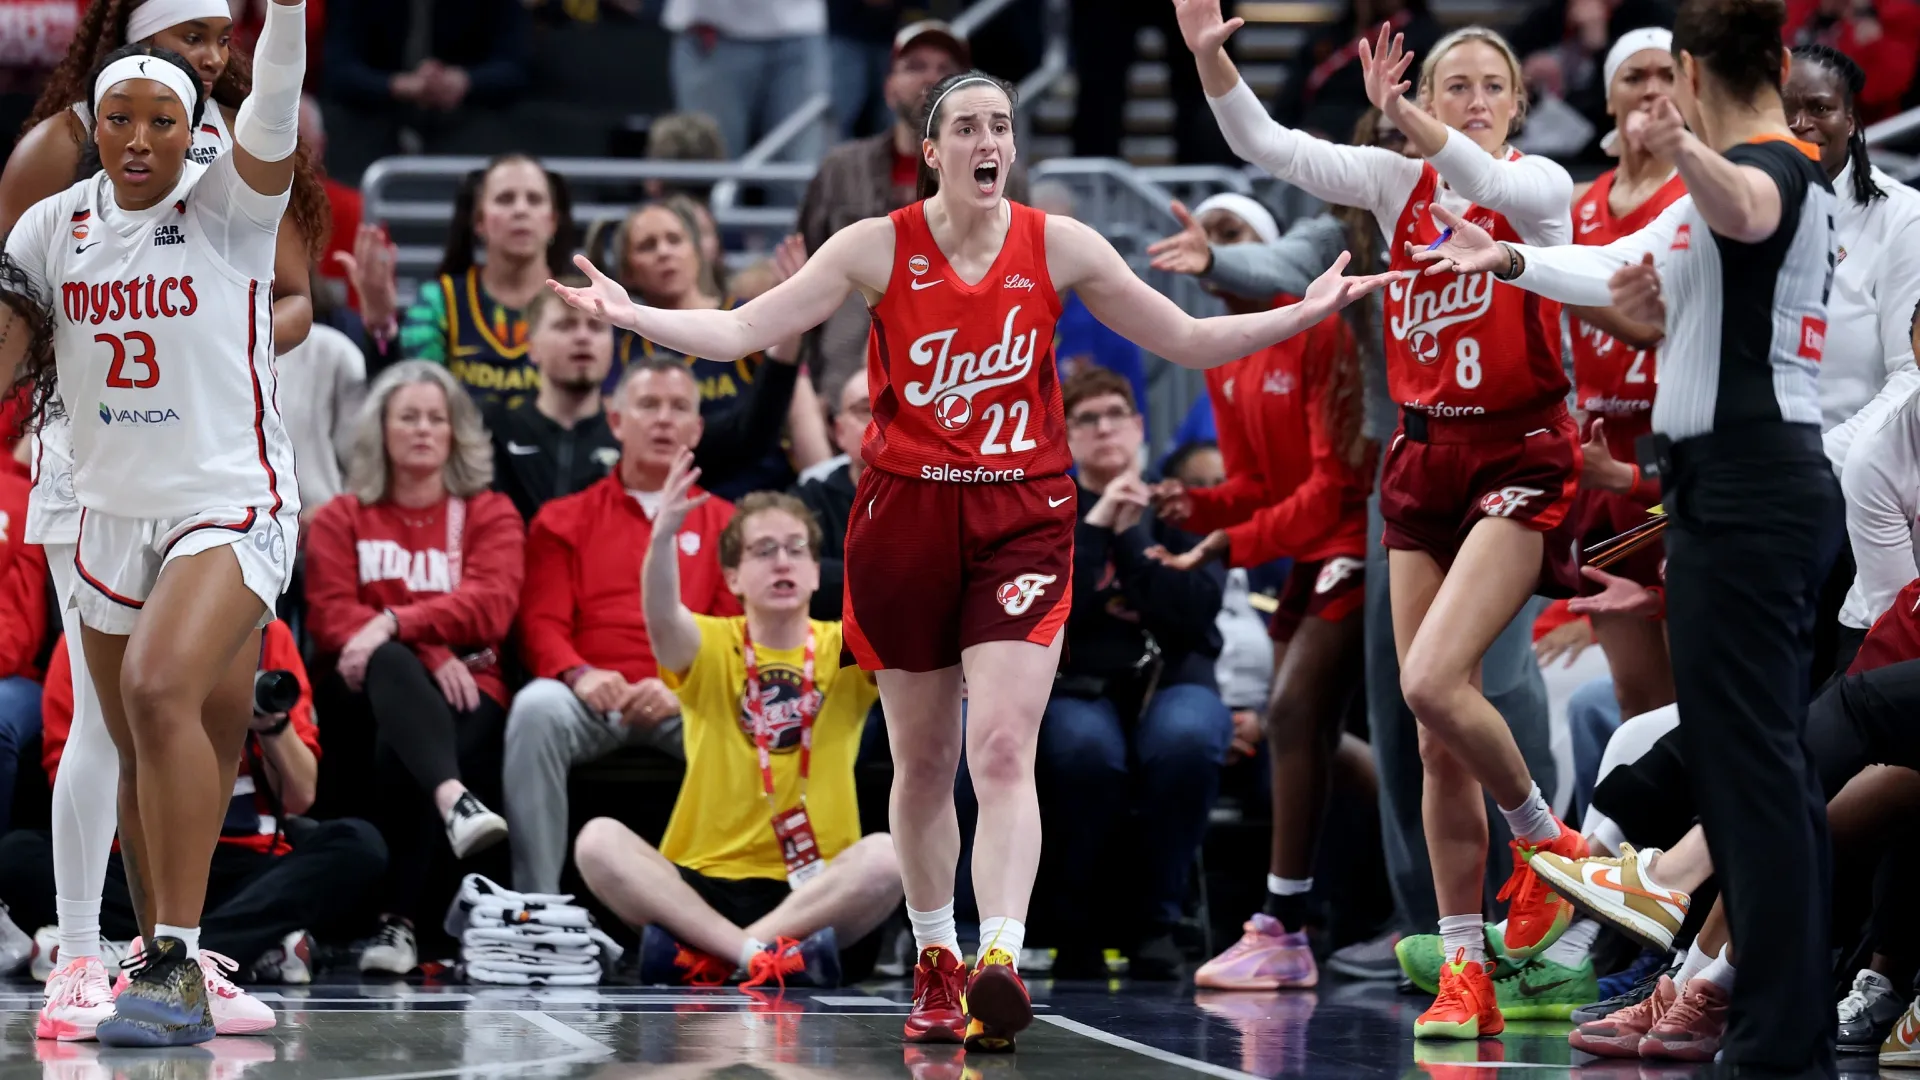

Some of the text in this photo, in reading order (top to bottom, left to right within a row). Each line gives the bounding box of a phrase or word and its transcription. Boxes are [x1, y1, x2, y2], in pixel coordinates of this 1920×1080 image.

[193, 147, 217, 157] CAR
[195, 155, 215, 165] ma
[154, 225, 179, 236] CAR
[154, 234, 186, 246] max
[1003, 273, 1035, 292] Lilly
[1389, 269, 1494, 340] Indy
[94, 330, 160, 389] 23
[904, 304, 1037, 407] Indy
[1455, 337, 1482, 389] 8
[111, 408, 180, 423] VANDA
[980, 400, 1037, 455] 22
[920, 463, 1025, 483] salesforce
[1003, 573, 1057, 616] F
